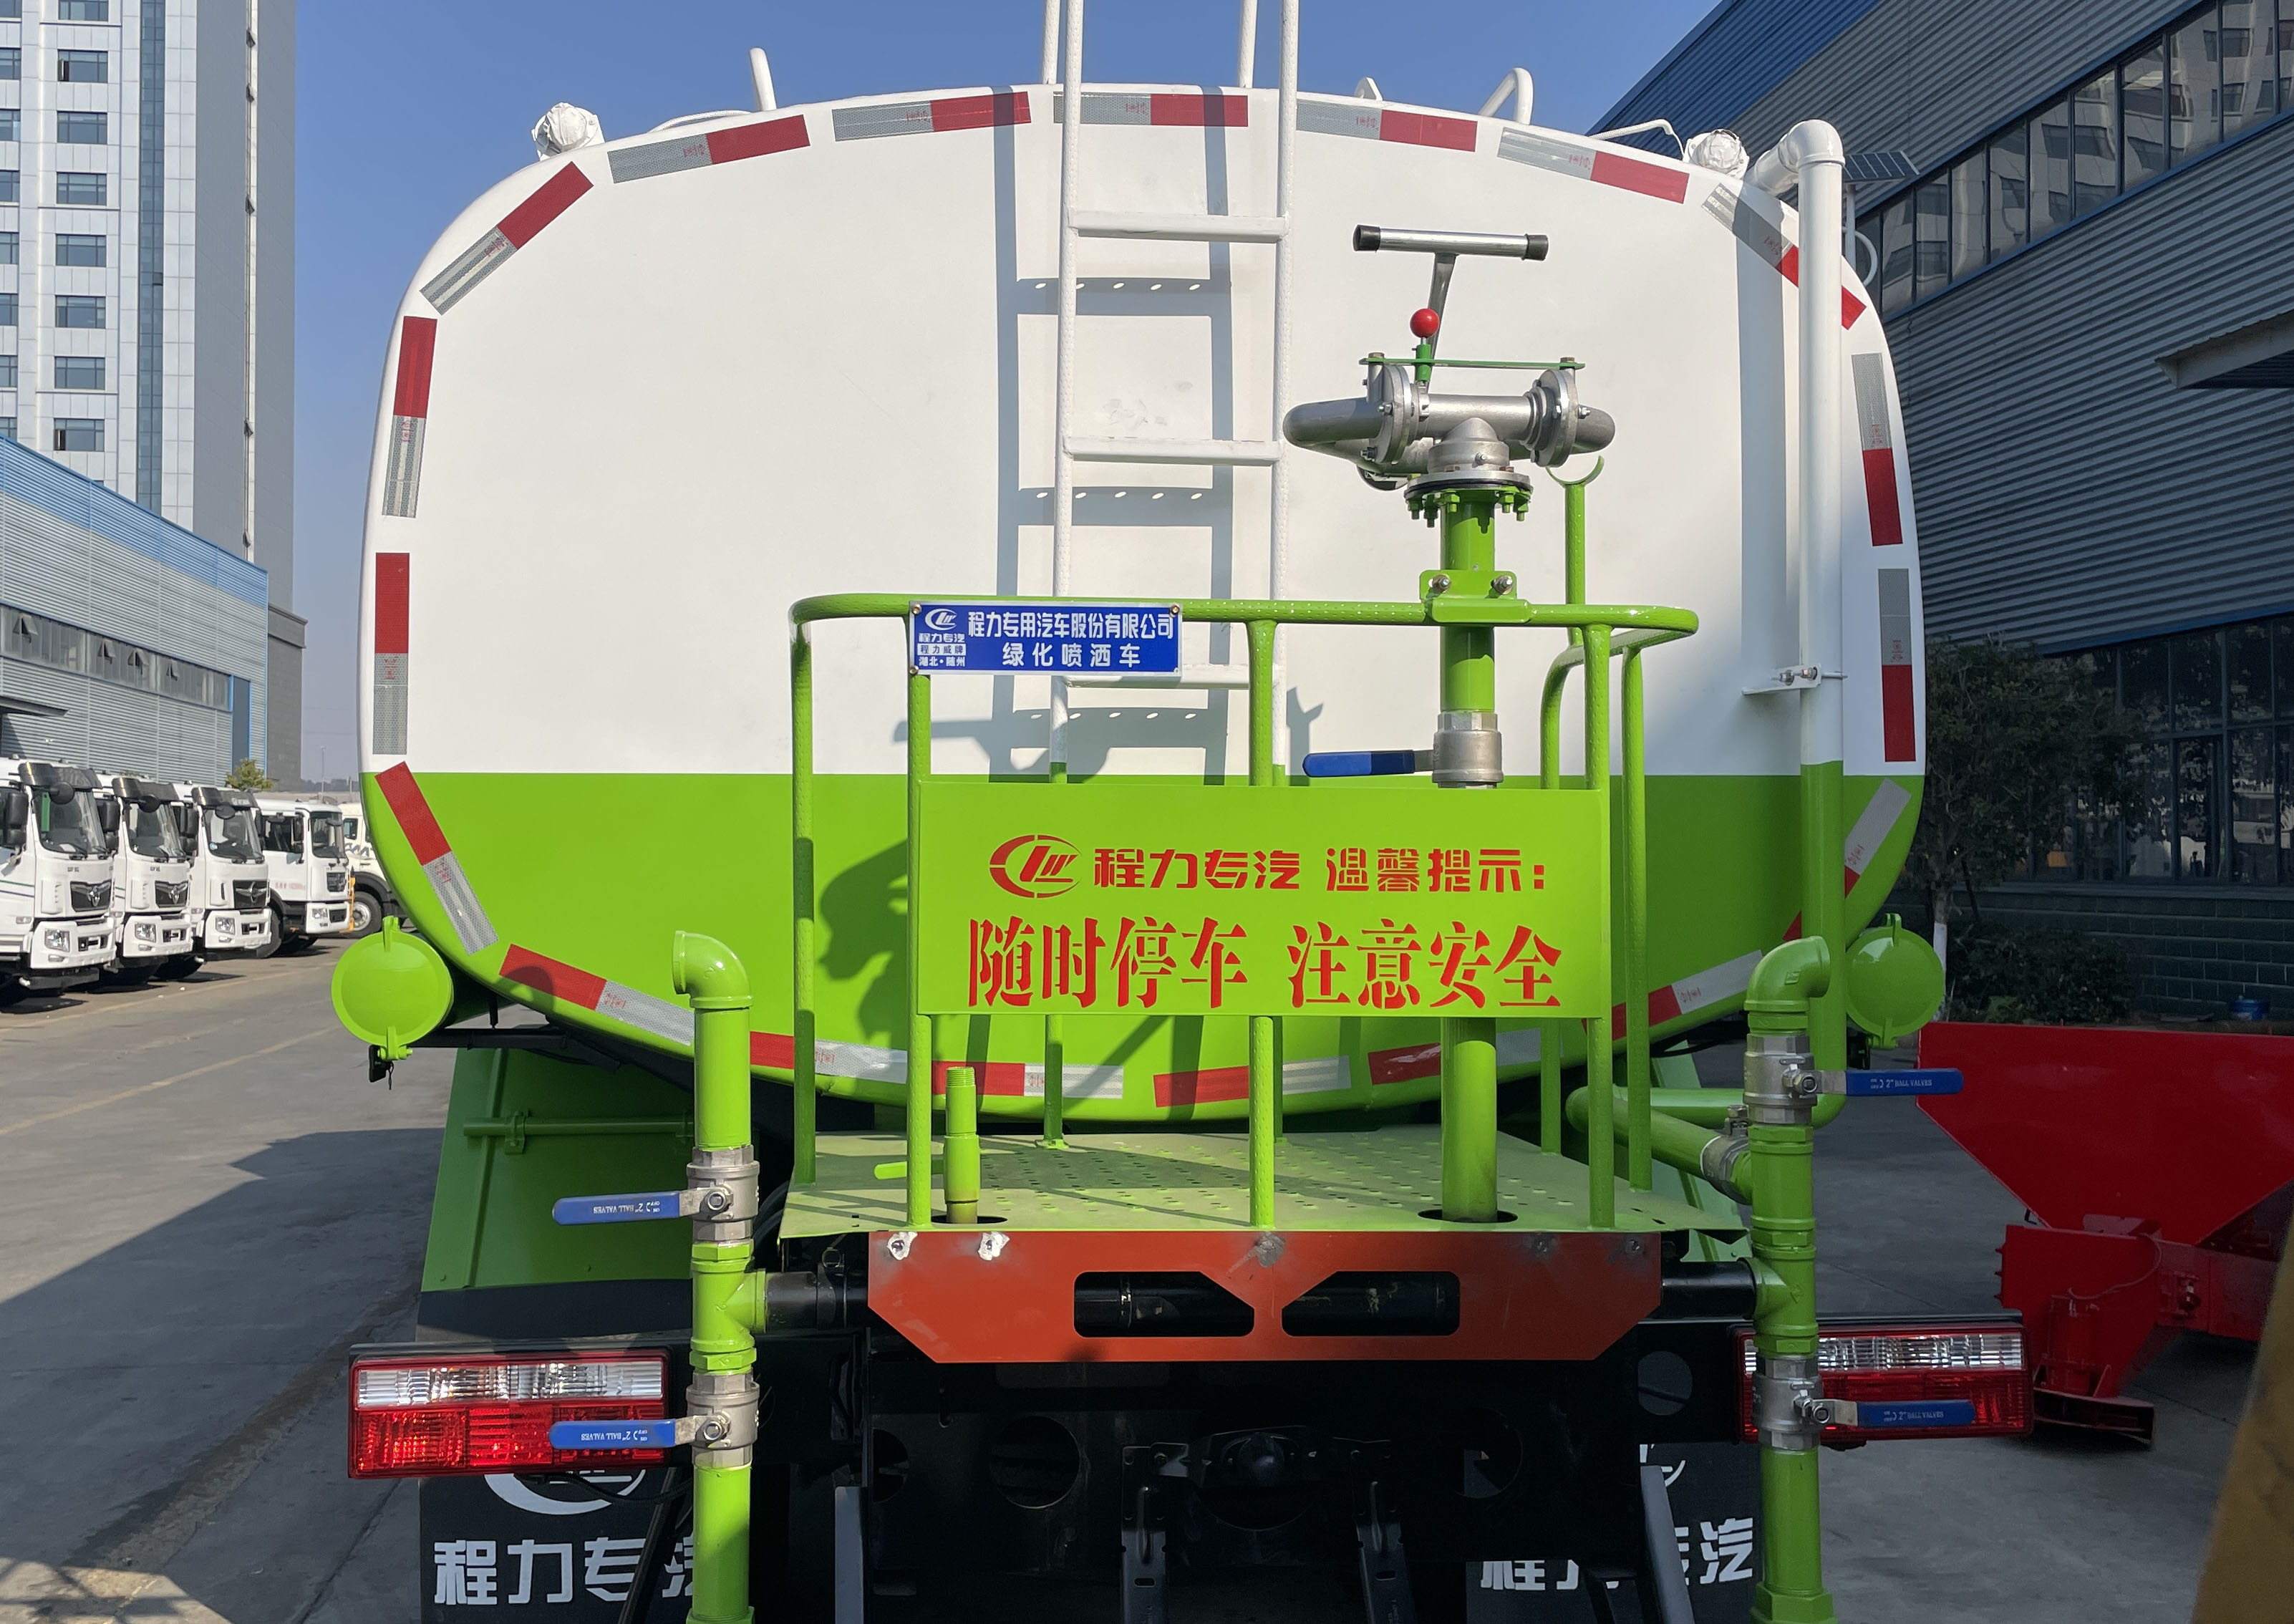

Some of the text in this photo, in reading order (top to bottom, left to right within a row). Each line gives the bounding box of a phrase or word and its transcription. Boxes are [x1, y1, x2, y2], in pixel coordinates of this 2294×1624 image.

[968, 611, 1173, 639] 程力专用汽车股份有限公司
[1002, 642, 1141, 668] 绿化喷洒车
[1093, 848, 1300, 890] 程力专汽
[969, 915, 1562, 1010] 随时停车 注意安全
[593, 1205, 617, 1214] VALVES
[581, 1433, 605, 1441] VALVES
